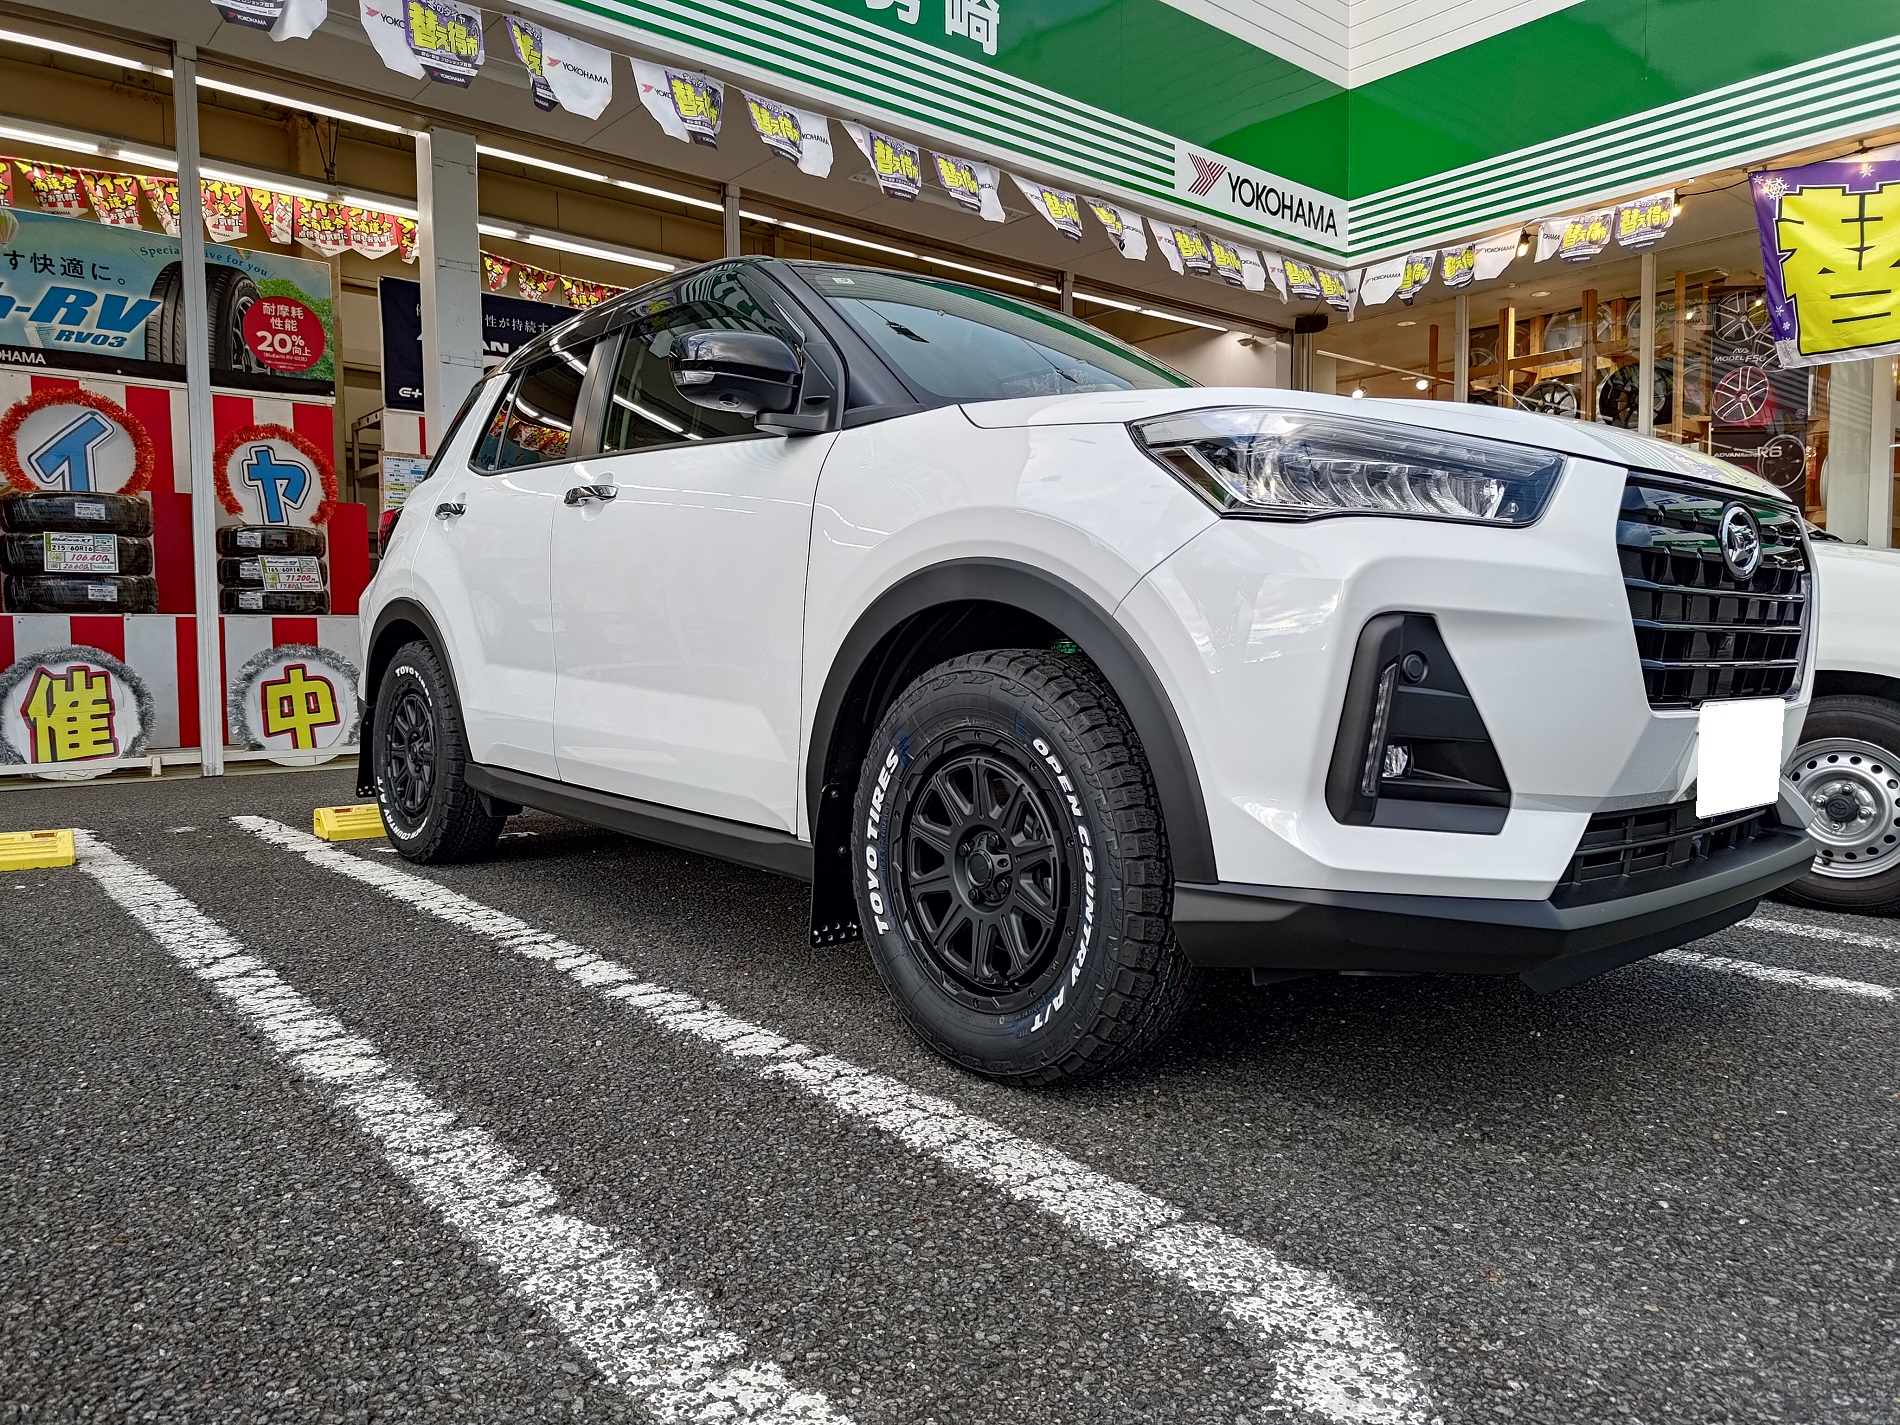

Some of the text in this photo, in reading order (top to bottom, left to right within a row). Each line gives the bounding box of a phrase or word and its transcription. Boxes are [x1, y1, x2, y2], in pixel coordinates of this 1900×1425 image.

[380, 13, 405, 29] YOKO
[408, 2, 479, 57] 替え得市
[562, 61, 610, 86] YOKOHAMA
[653, 87, 673, 99] YOKO
[1227, 172, 1338, 237] YOKOHAMA
[1619, 205, 1669, 237] 替え得市
[139, 246, 180, 258] Specia
[226, 255, 244, 267] for
[246, 263, 268, 277] you
[1484, 244, 1516, 254] YOKOHAMA
[1371, 272, 1402, 282] YOKOHAMA
[262, 302, 304, 319] 耐摩耗
[270, 317, 298, 332] 性能
[485, 314, 556, 334] 性が持続す
[54, 330, 128, 348] RV03
[256, 330, 312, 357] 20% 向上
[0, 350, 46, 365] HAMA
[1714, 354, 1767, 363] MODEL F50
[27, 410, 117, 492] イ
[1756, 446, 1782, 458] R6
[241, 444, 312, 526] ヤ
[51, 544, 93, 552] 215/60R16
[394, 665, 415, 679] TOYO
[20, 666, 120, 764] 催
[261, 663, 341, 749] 中
[866, 747, 899, 840] TIRES
[383, 808, 412, 841] COUNTRY
[865, 845, 890, 935] TOYO
[1030, 737, 1097, 1033] OPEN COUNTRY A/T
